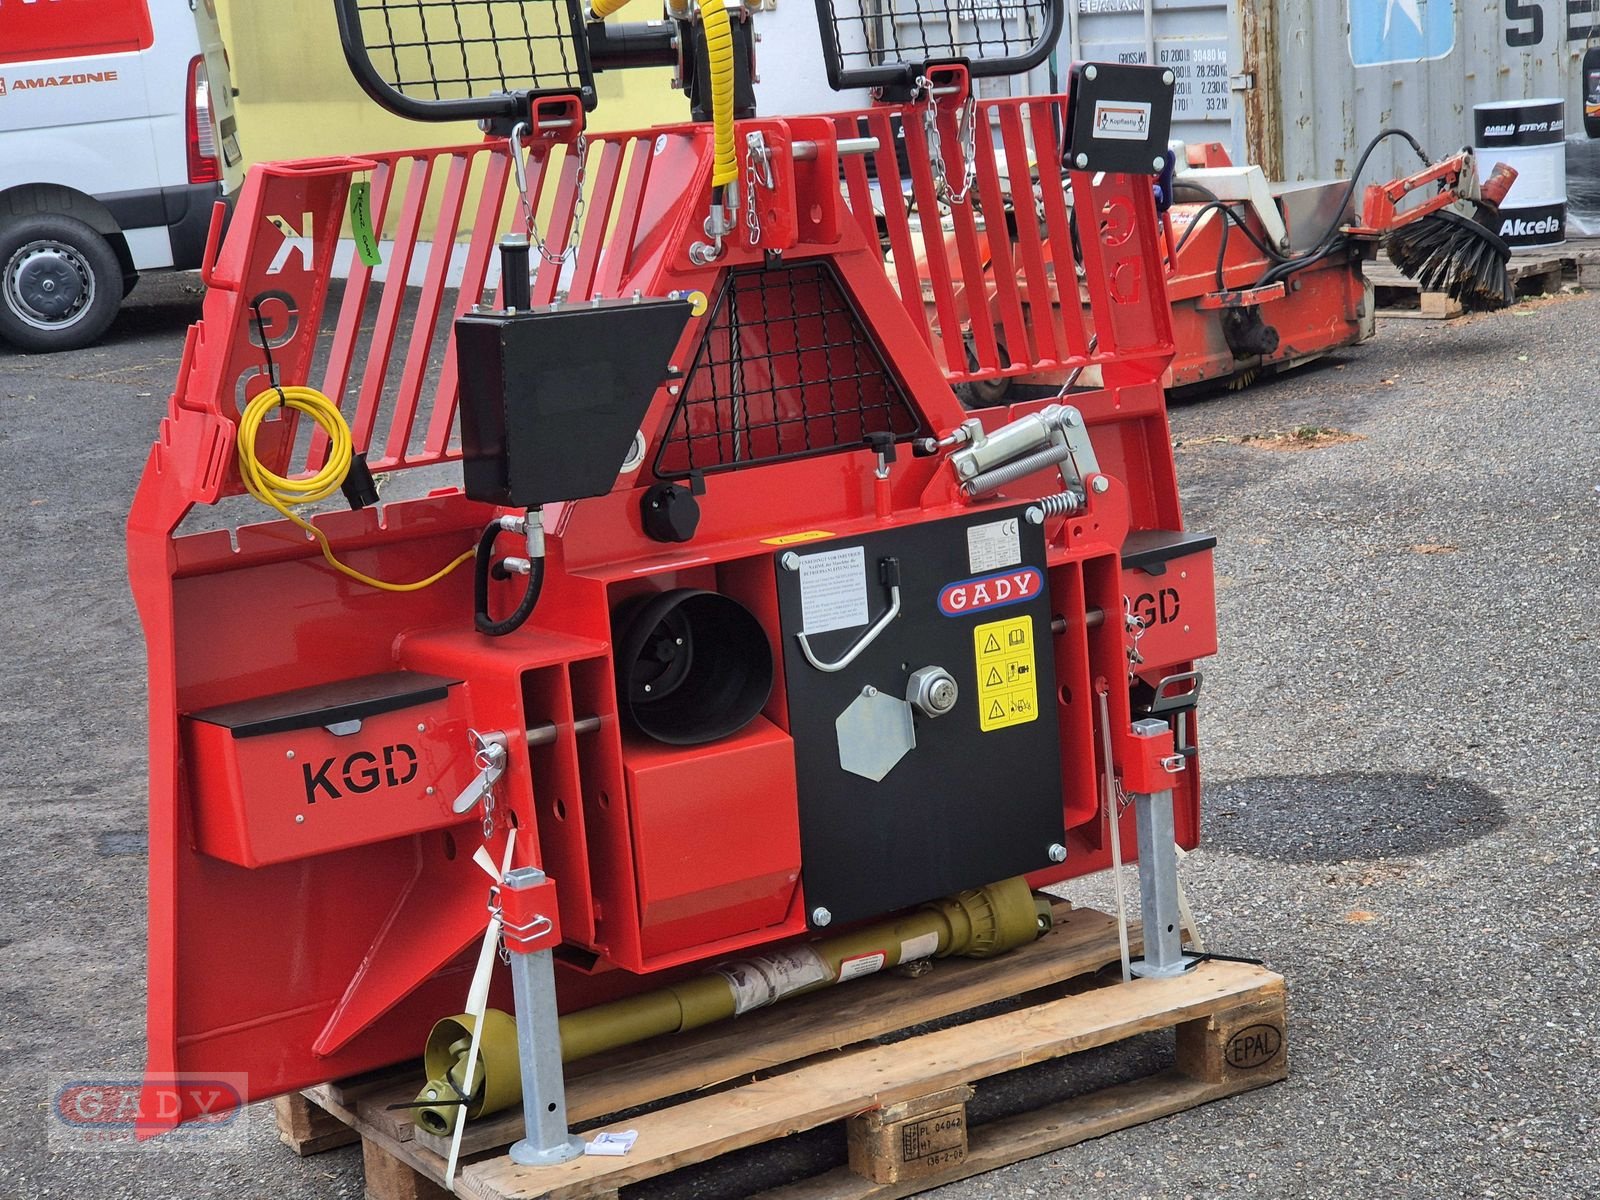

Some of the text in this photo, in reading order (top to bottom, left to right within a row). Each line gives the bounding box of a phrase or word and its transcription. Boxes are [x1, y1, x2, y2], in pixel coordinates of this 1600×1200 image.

[1079, 0, 1145, 13] SEALAN
[958, 9, 1017, 20] SEALAN
[1118, 51, 1138, 64] GROSS
[1193, 49, 1216, 62] 30480
[1217, 49, 1227, 63] kg
[1220, 65, 1228, 77] KG
[12, 71, 118, 90] AMAZONE
[1220, 81, 1229, 94] KG
[1109, 117, 1137, 127] Kopflastig
[1518, 122, 1548, 132] STEYR
[1500, 216, 1560, 237] Akcela
[948, 573, 1032, 611] GADY
[302, 743, 419, 805] KGD
[1233, 1032, 1275, 1062] EPAL
[920, 1127, 930, 1136] PL
[920, 1140, 931, 1151] HT
